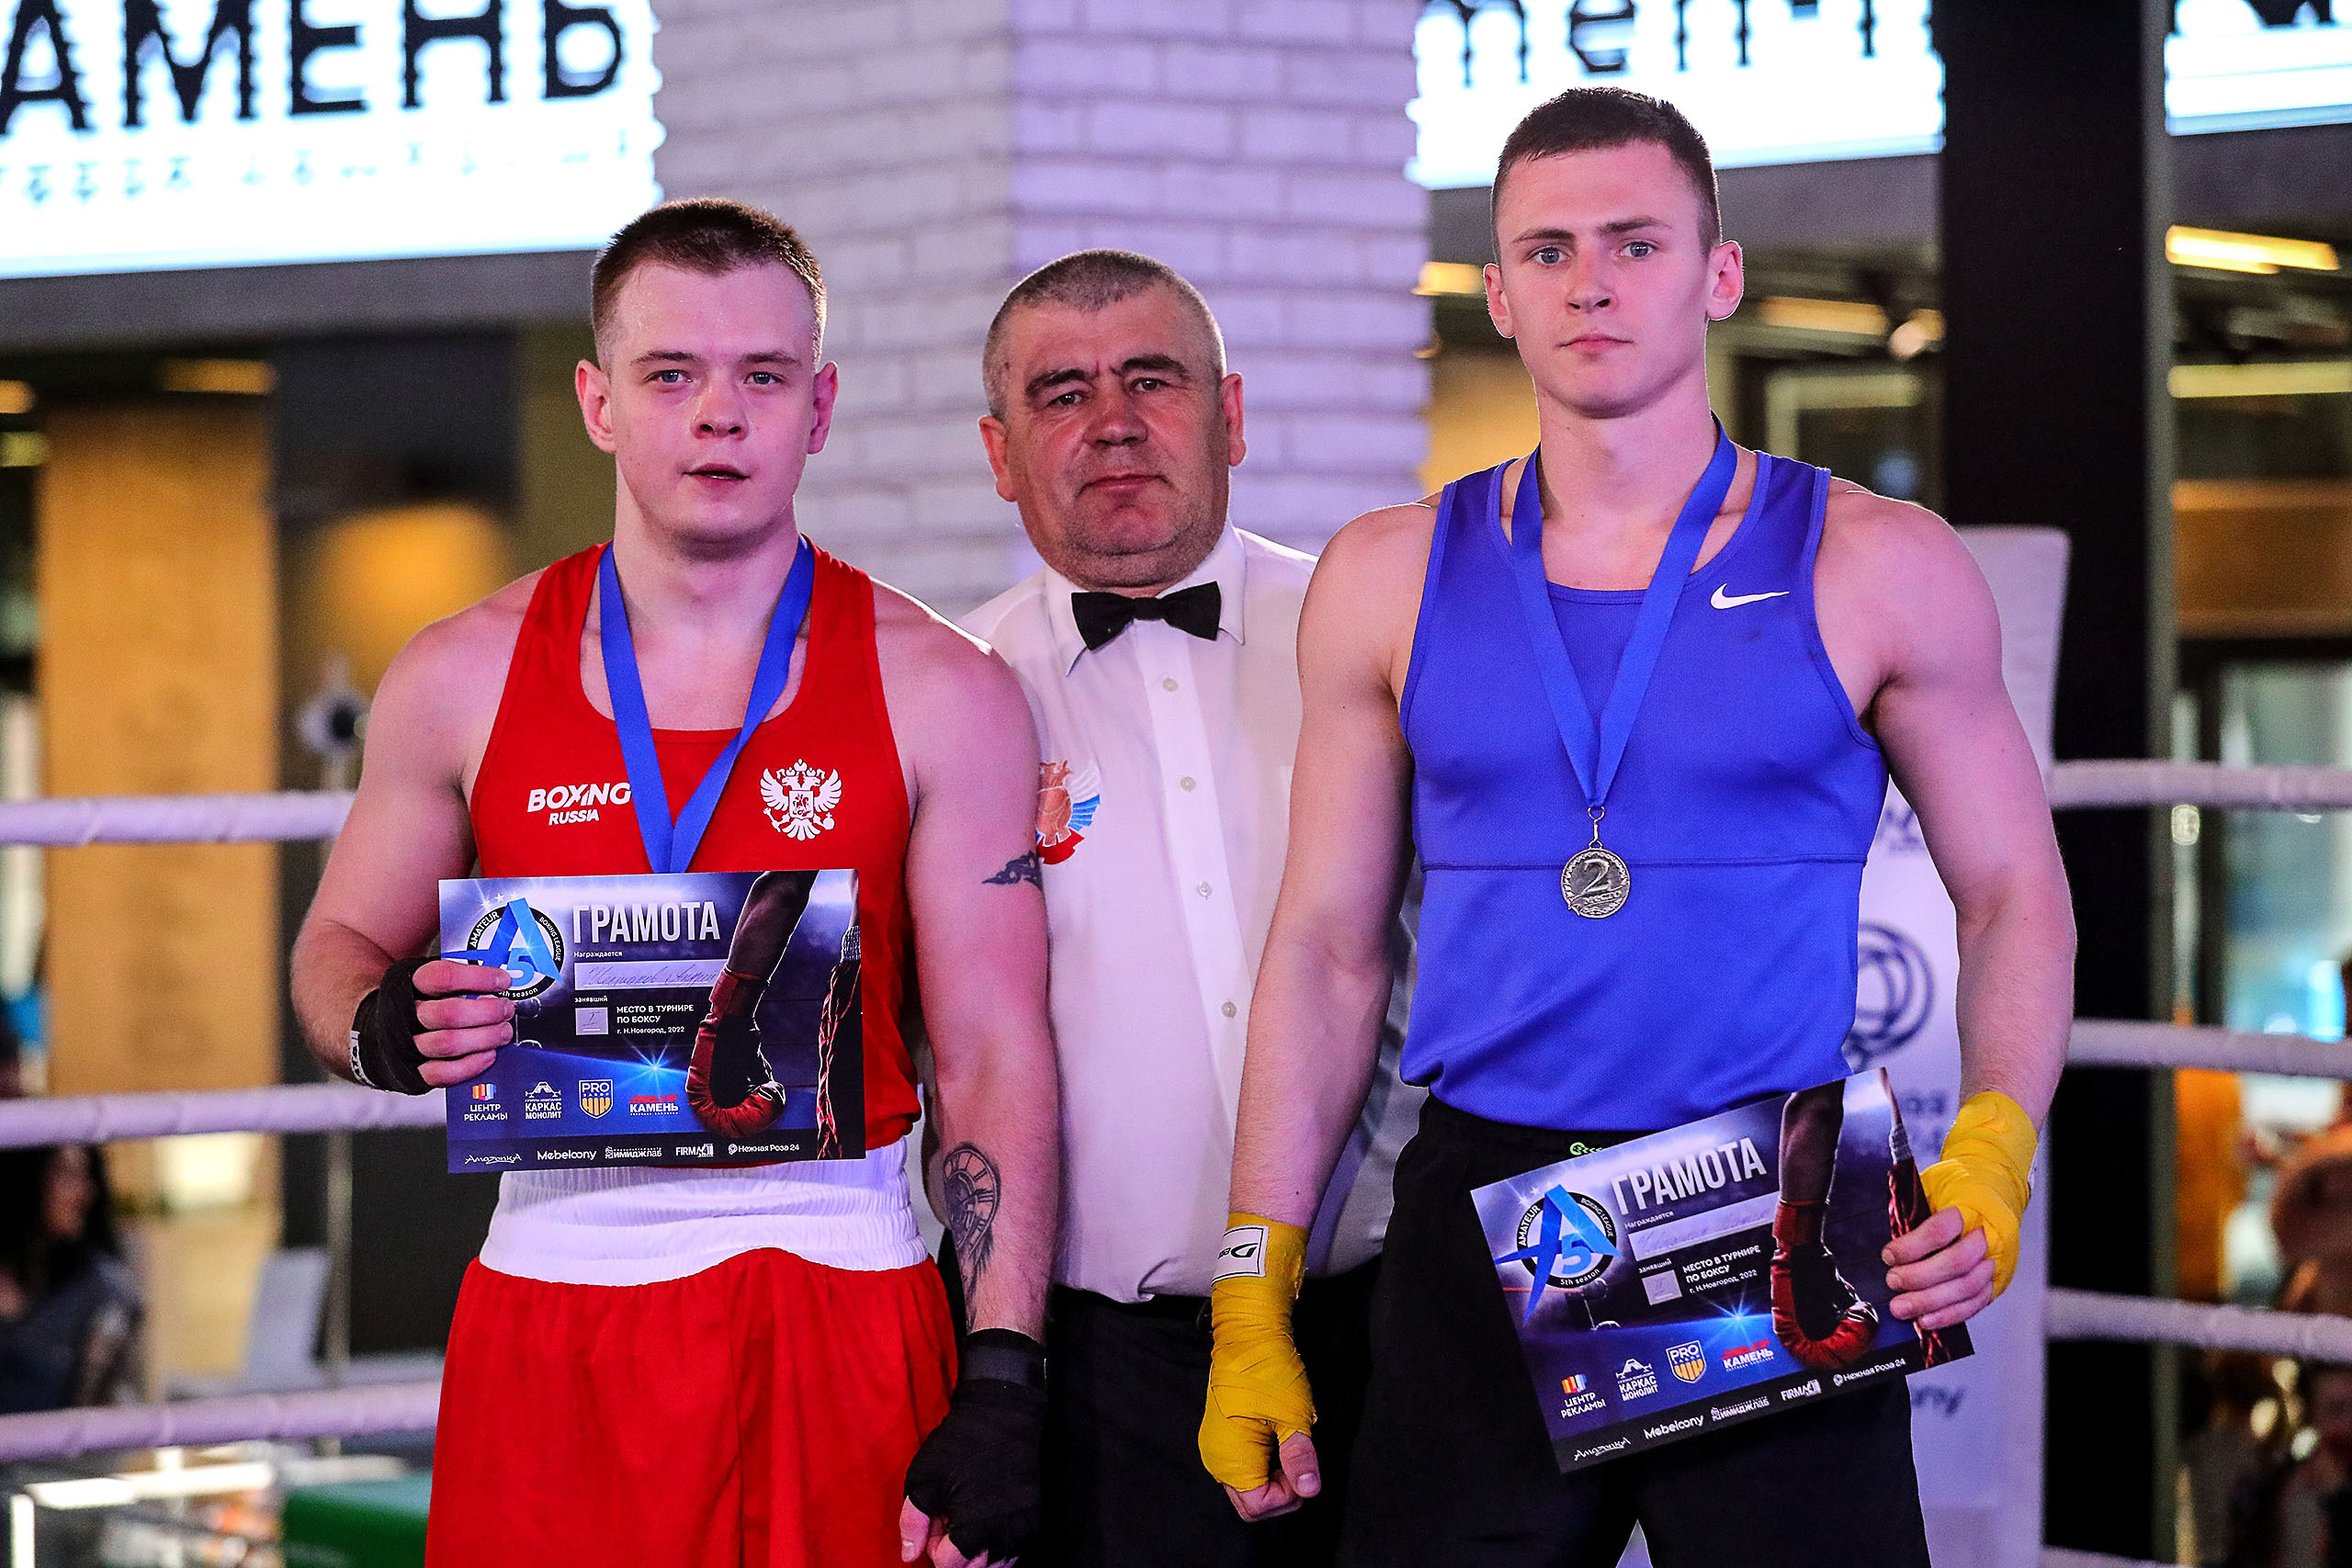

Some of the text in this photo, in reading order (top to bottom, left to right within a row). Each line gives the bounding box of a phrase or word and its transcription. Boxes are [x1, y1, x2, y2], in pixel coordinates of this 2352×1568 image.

[548, 809, 600, 826] RUSSIA
[1580, 858, 1611, 896] 2
[571, 900, 721, 944] ГРАМОТА
[469, 910, 501, 949] AMATEUR
[538, 916, 563, 963] BOXING LEAGUE
[572, 951, 623, 960] Награждается
[511, 987, 539, 998] season
[574, 995, 608, 1003] занявший
[616, 1004, 695, 1014] МЕСТО В ТУРНИРЕ
[616, 1015, 662, 1024] ПО БОКСУ
[667, 1025, 685, 1033] 2022
[582, 1082, 610, 1093] PRO
[659, 1094, 679, 1103] VIP
[469, 1103, 502, 1112] ЦЕНТР
[525, 1102, 562, 1112] КАРКАС
[629, 1102, 679, 1113] КАМЕНЬ
[463, 1111, 508, 1122] РЕКЛАМЫ
[525, 1111, 562, 1120] МОНОЛИТ
[738, 1145, 769, 1153] Нежная
[769, 1144, 790, 1152] Роза
[1610, 1136, 1768, 1216] ГРАМОТА
[1518, 1204, 1541, 1247] AMATEUR
[1623, 1210, 1675, 1230] Награждается
[1681, 1245, 1762, 1274] МЕСТО В ТУРНИРЕ
[1575, 1268, 1600, 1284] season
[1685, 1264, 1731, 1284] ПО БОКСУ
[1739, 1269, 1758, 1280] 2022
[1749, 1338, 1770, 1351] VIP
[1668, 1344, 1700, 1361] PRO
[1723, 1348, 1774, 1369] КАМЕНЬ
[1894, 1357, 1906, 1368] 24
[1618, 1375, 1657, 1393] КАРКАС
[1564, 1392, 1597, 1407] ЦЕНТР
[1621, 1383, 1659, 1402] МОНОЛИТ
[1560, 1398, 1607, 1419] РЕКЛАМЫ
